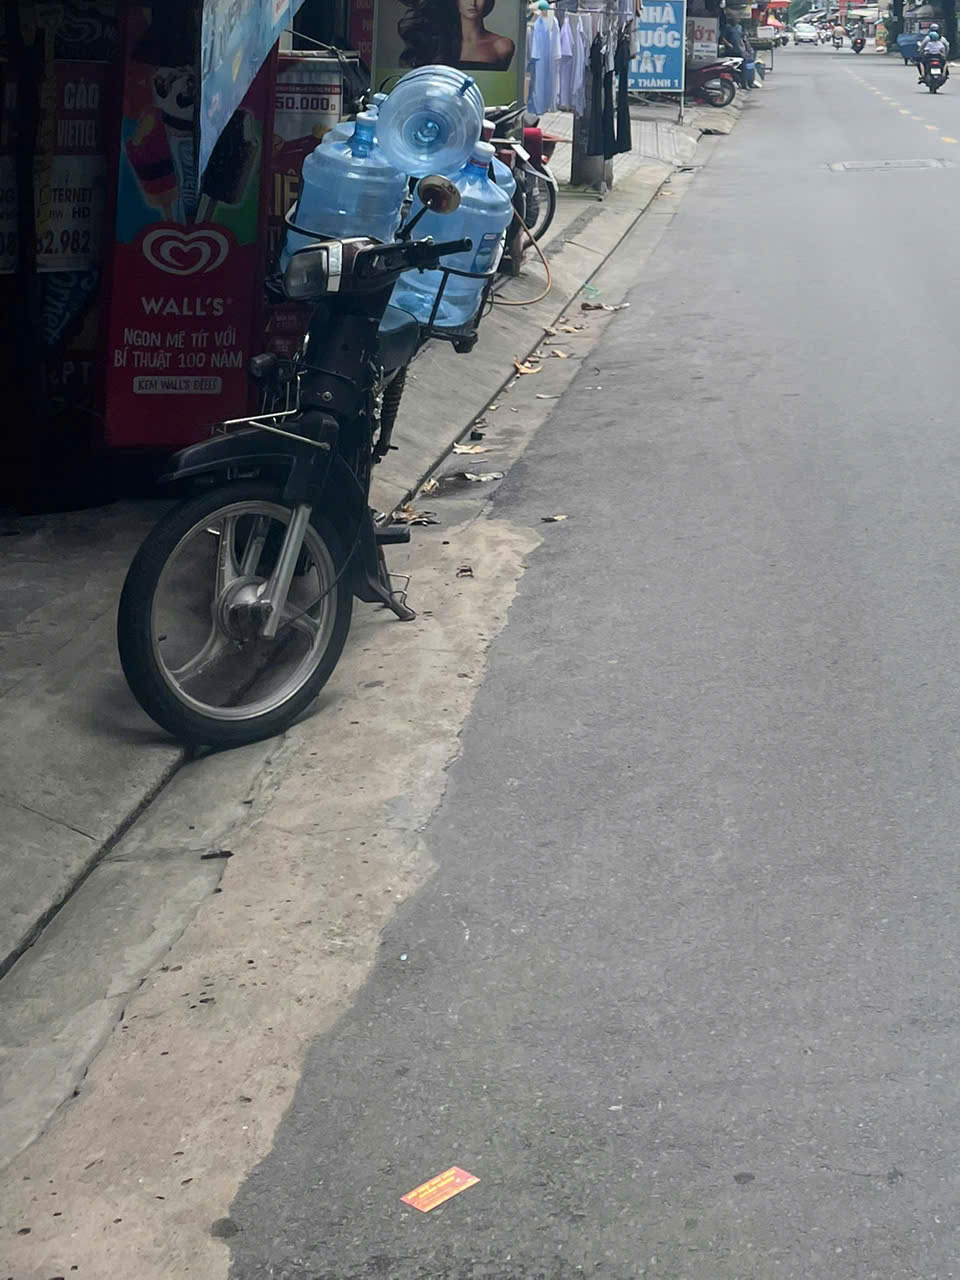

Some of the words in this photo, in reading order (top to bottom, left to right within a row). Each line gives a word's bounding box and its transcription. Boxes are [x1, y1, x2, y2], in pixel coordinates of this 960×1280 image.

[641, 2, 677, 24] NHÀ
[639, 24, 681, 48] UỐC
[631, 51, 667, 73] TÂY
[638, 78, 671, 88] THÀNH
[140, 295, 225, 317] WALL'S
[123, 327, 161, 347] NGON
[214, 322, 237, 347] VỚI
[113, 346, 129, 368] BÍ
[132, 349, 173, 371] THUẬT
[177, 351, 206, 368] 100
